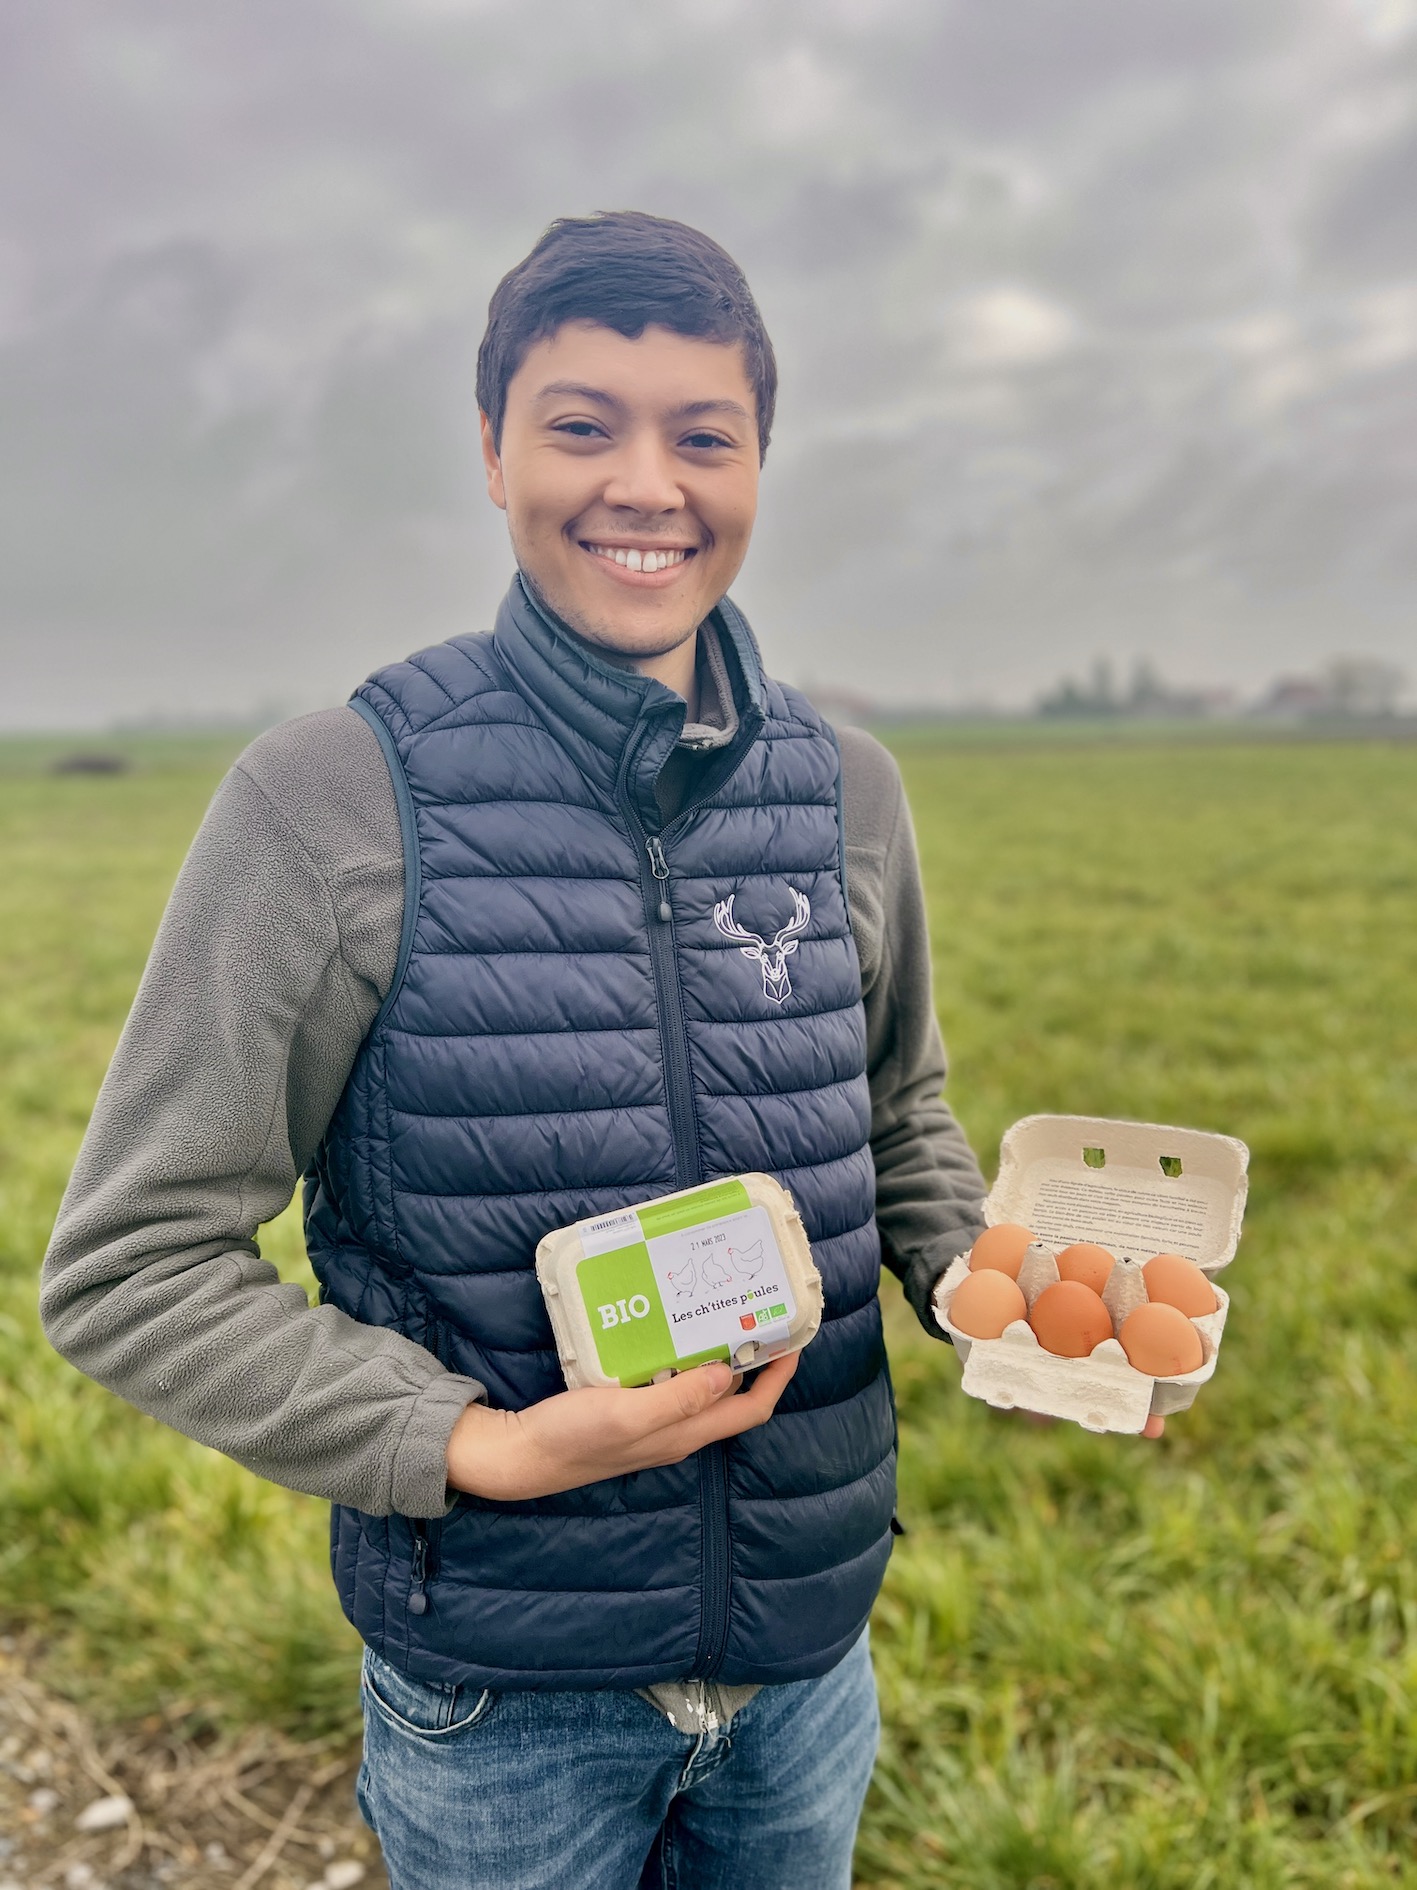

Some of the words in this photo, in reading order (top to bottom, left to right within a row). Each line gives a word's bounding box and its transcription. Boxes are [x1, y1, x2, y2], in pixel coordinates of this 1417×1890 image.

[714, 1233, 727, 1244] 2023
[597, 1294, 651, 1330] BIO
[672, 1310, 693, 1324] Les
[695, 1297, 738, 1318] ch'tites
